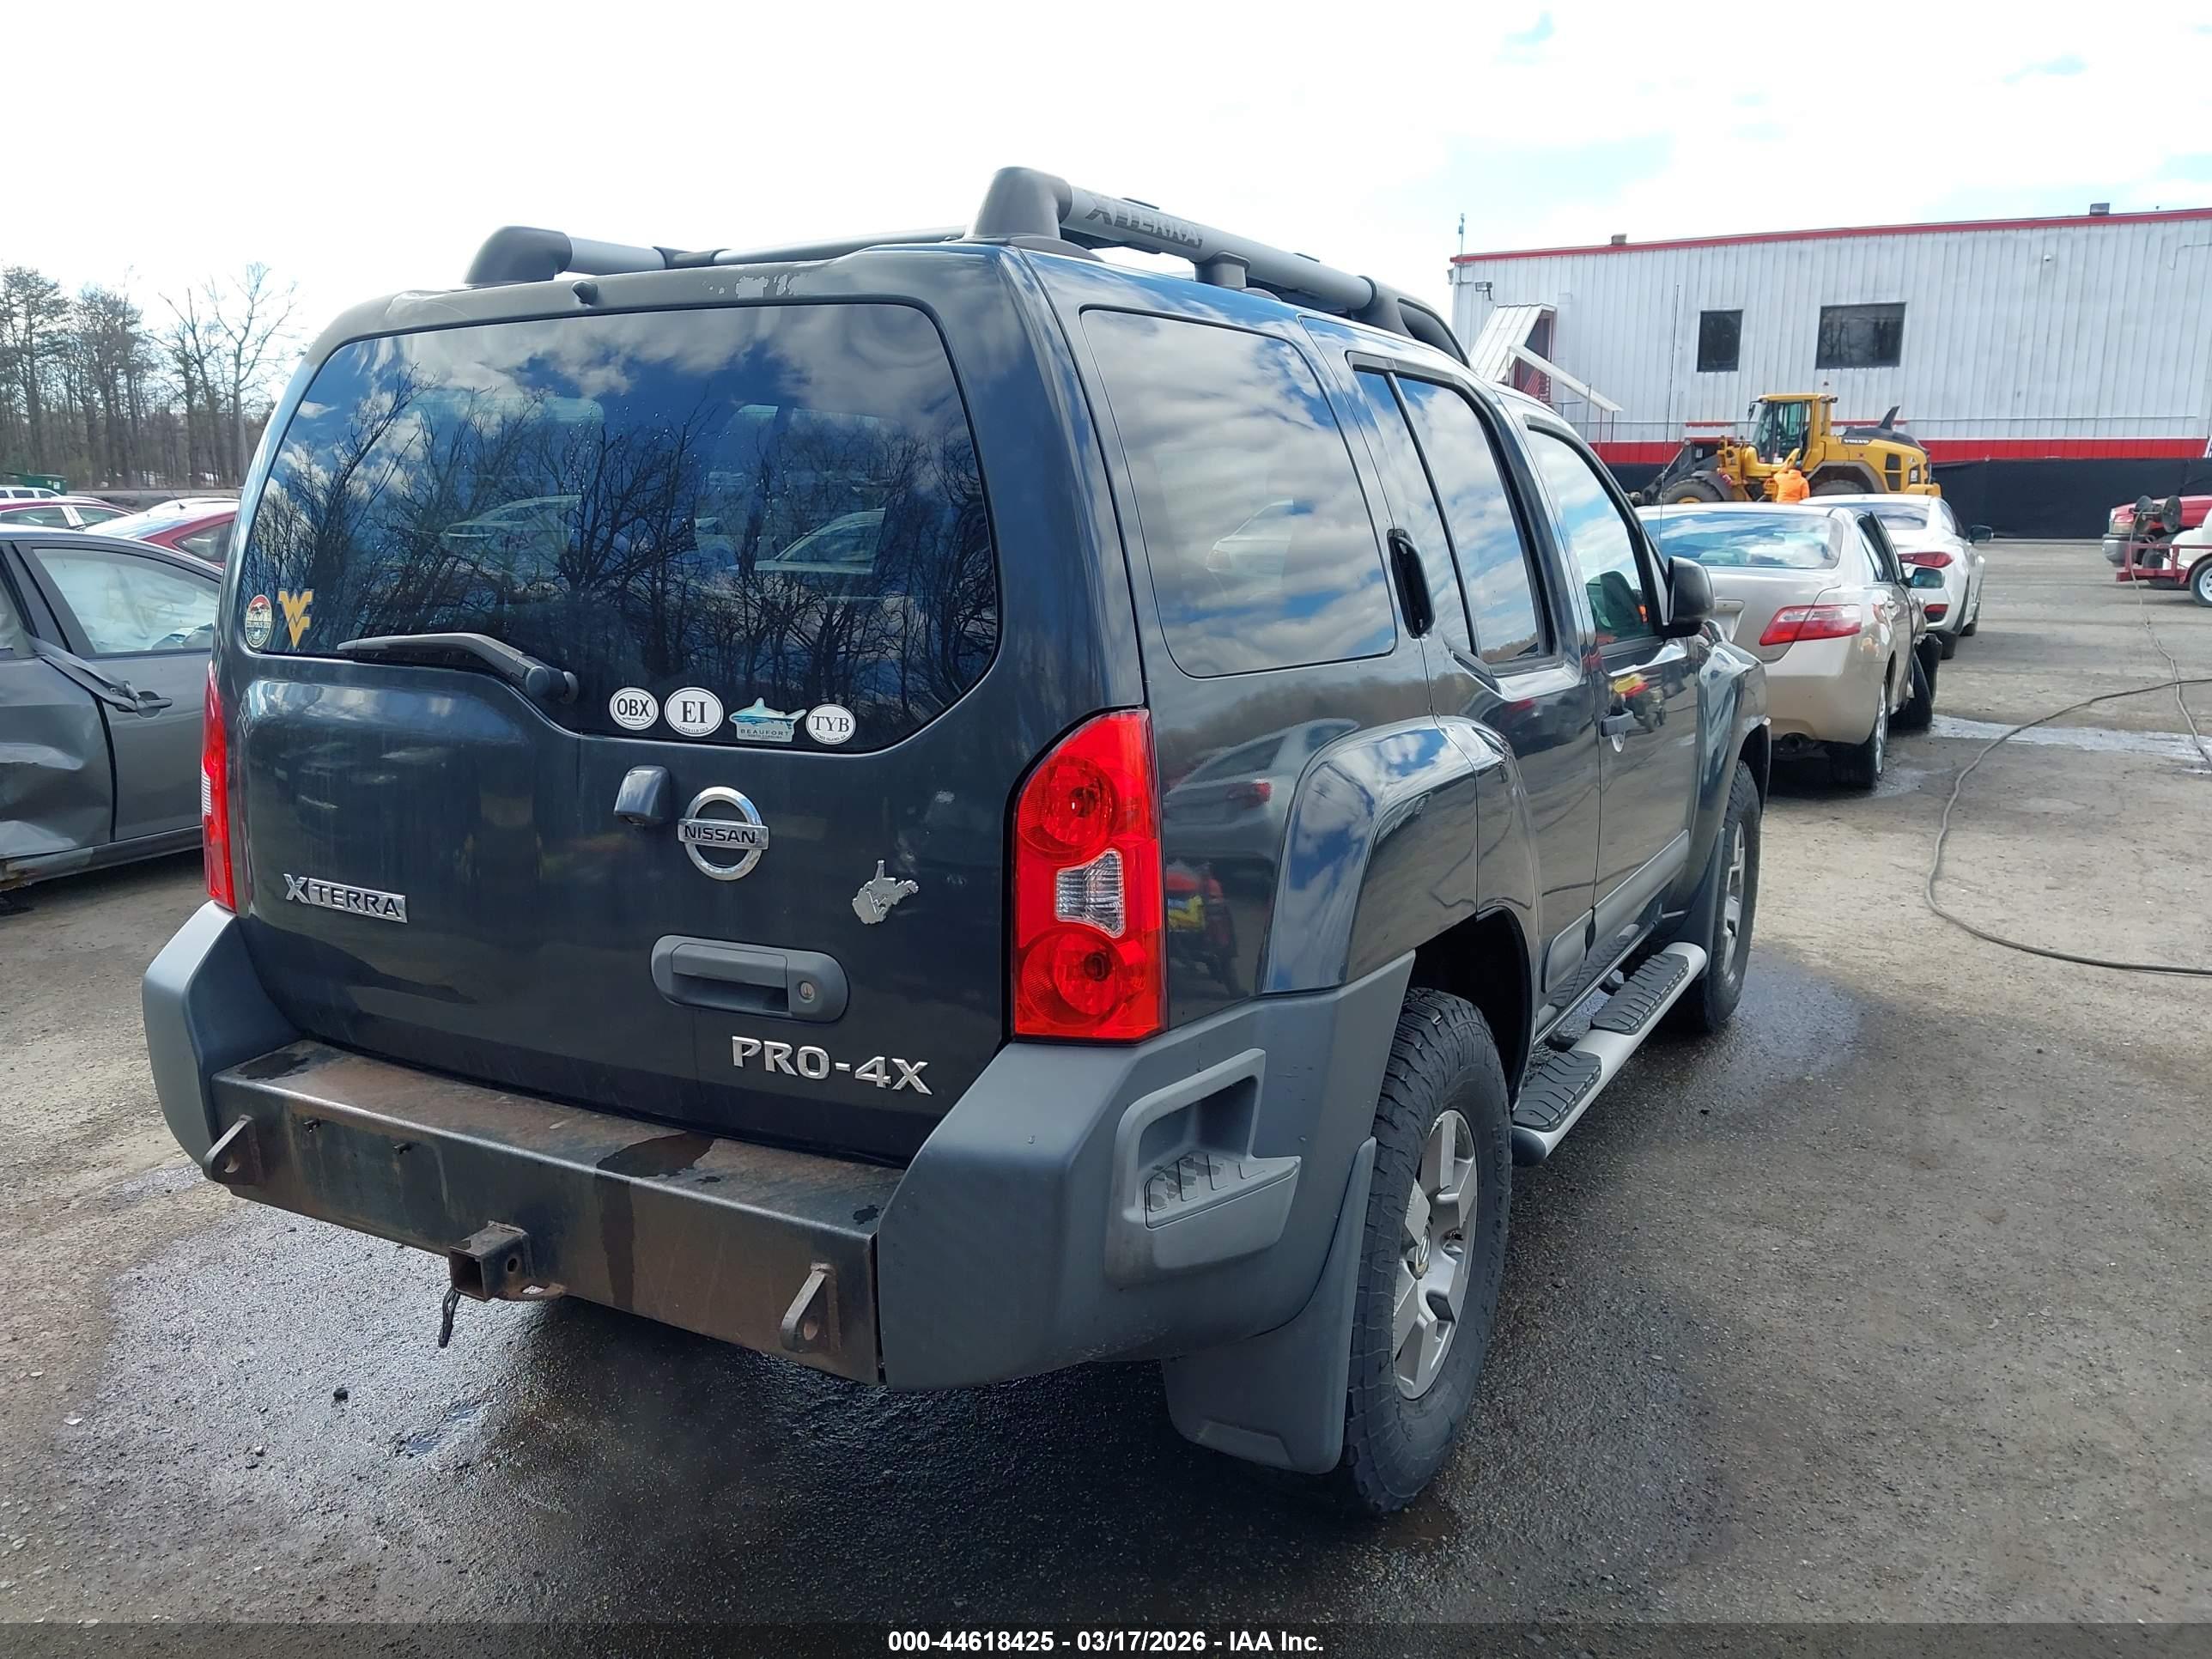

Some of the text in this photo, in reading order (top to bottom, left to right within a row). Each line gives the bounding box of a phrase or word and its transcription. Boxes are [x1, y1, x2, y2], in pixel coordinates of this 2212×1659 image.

[617, 697, 652, 718] OBX
[679, 700, 708, 724] EI
[811, 715, 849, 732] TYB
[684, 824, 756, 844] NISSAN
[283, 873, 406, 922] XTERRA
[732, 1035, 933, 1096] PRO-4X
